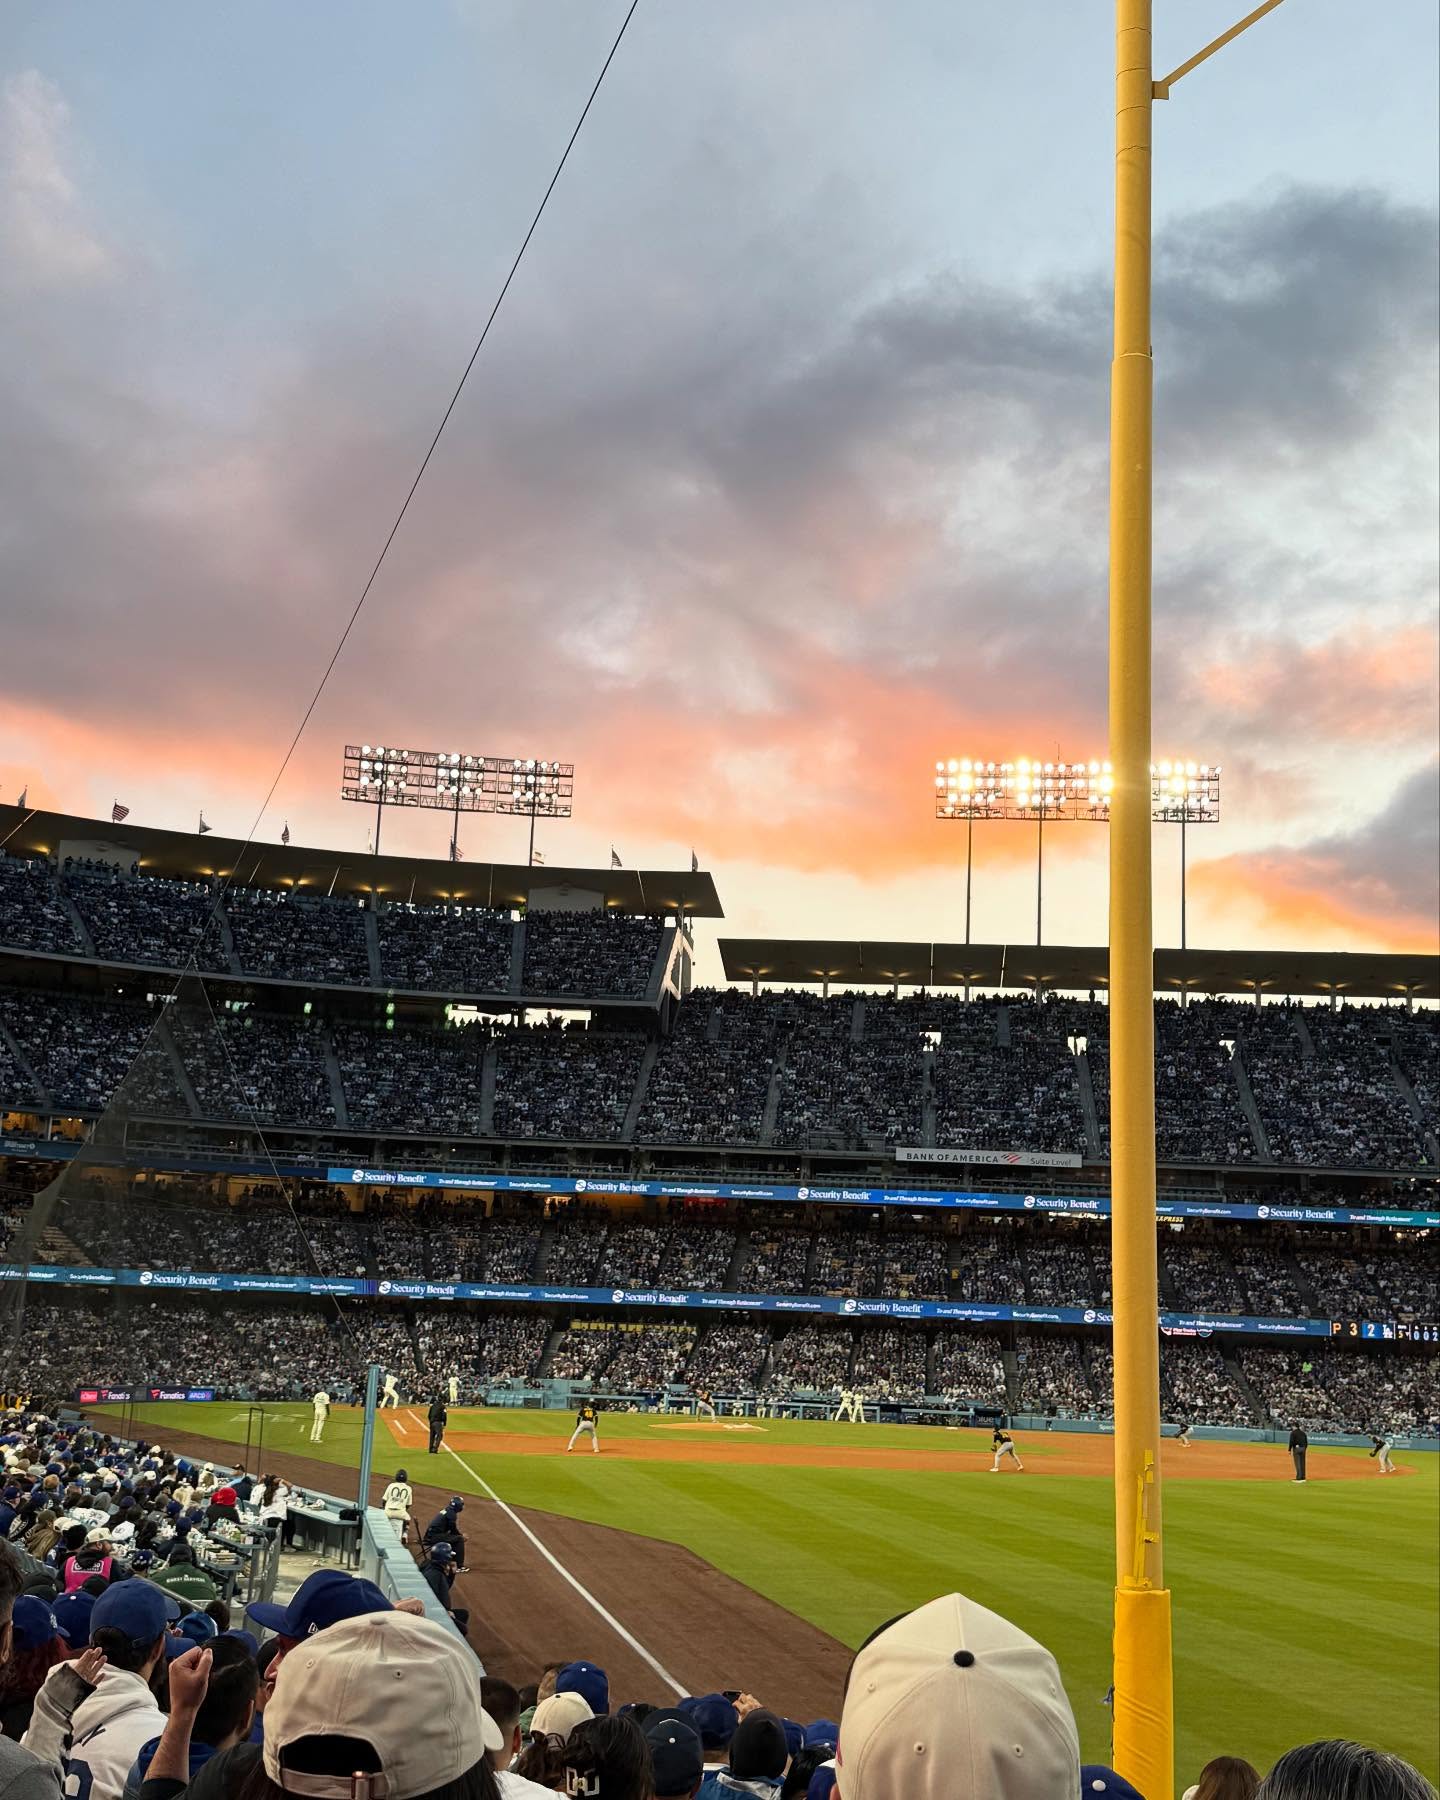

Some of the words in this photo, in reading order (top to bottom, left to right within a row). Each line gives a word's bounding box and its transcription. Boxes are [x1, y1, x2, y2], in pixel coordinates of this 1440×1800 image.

[952, 1154, 998, 1163] AMERICA
[1031, 1158, 1050, 1166] Suite
[1052, 1159, 1072, 1167] Level
[364, 1172, 396, 1184] Security
[398, 1174, 425, 1184] Benefit
[587, 1182, 618, 1192] Security
[619, 1183, 648, 1192] Benefit
[810, 1190, 842, 1200] Security
[843, 1192, 870, 1200] Benefit
[1036, 1198, 1068, 1209] Security
[1070, 1199, 1098, 1208] Benefit
[1270, 1208, 1303, 1219] Security
[1306, 1210, 1334, 1219] Benefit
[154, 1274, 187, 1286] Security
[188, 1276, 219, 1286] Benefit
[392, 1284, 424, 1294] Security
[426, 1285, 456, 1294] Benefit
[624, 1292, 657, 1303] Security
[658, 1294, 688, 1303] Benefit
[858, 1302, 891, 1313] Security
[892, 1304, 922, 1313] Benefit
[1332, 1323, 1342, 1334] P
[1350, 1323, 1358, 1336] 3
[1368, 1324, 1375, 1336] 2
[1414, 1331, 1420, 1340] 0
[1423, 1331, 1430, 1340] 0
[1432, 1332, 1438, 1342] 2
[108, 1392, 130, 1400] Fanatis
[160, 1392, 186, 1400] Fanatics
